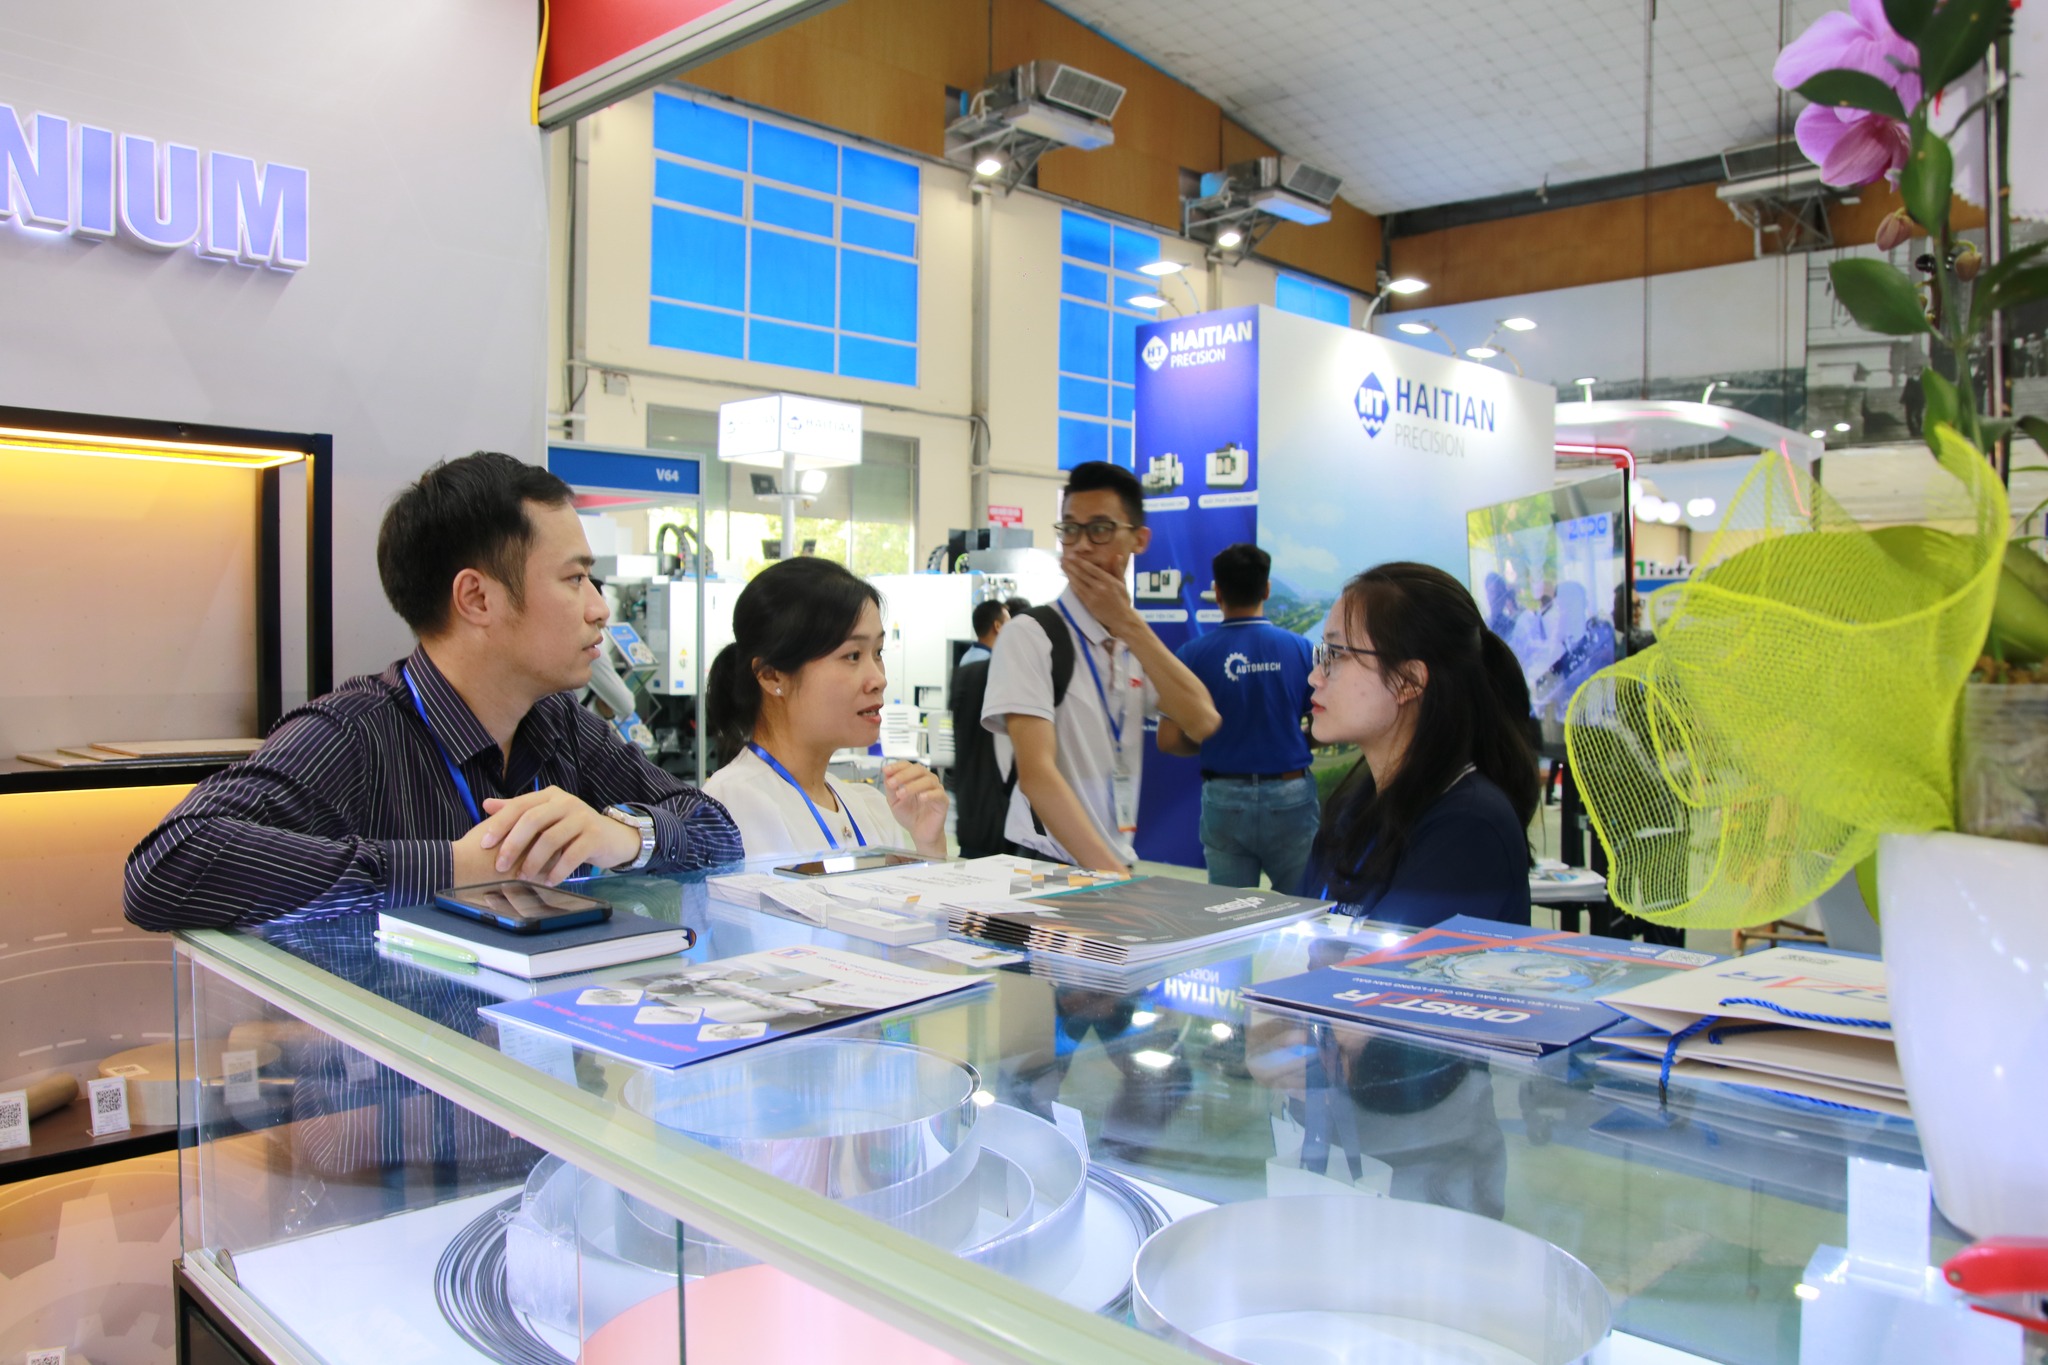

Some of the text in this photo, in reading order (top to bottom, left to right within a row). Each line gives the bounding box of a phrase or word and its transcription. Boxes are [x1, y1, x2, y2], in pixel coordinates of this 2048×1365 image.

[1170, 320, 1253, 353] HAITIAN
[1170, 348, 1226, 369] PRECISION
[1396, 376, 1495, 433] HAITIAN
[1394, 423, 1466, 459] PRECISION
[656, 467, 680, 483] V64
